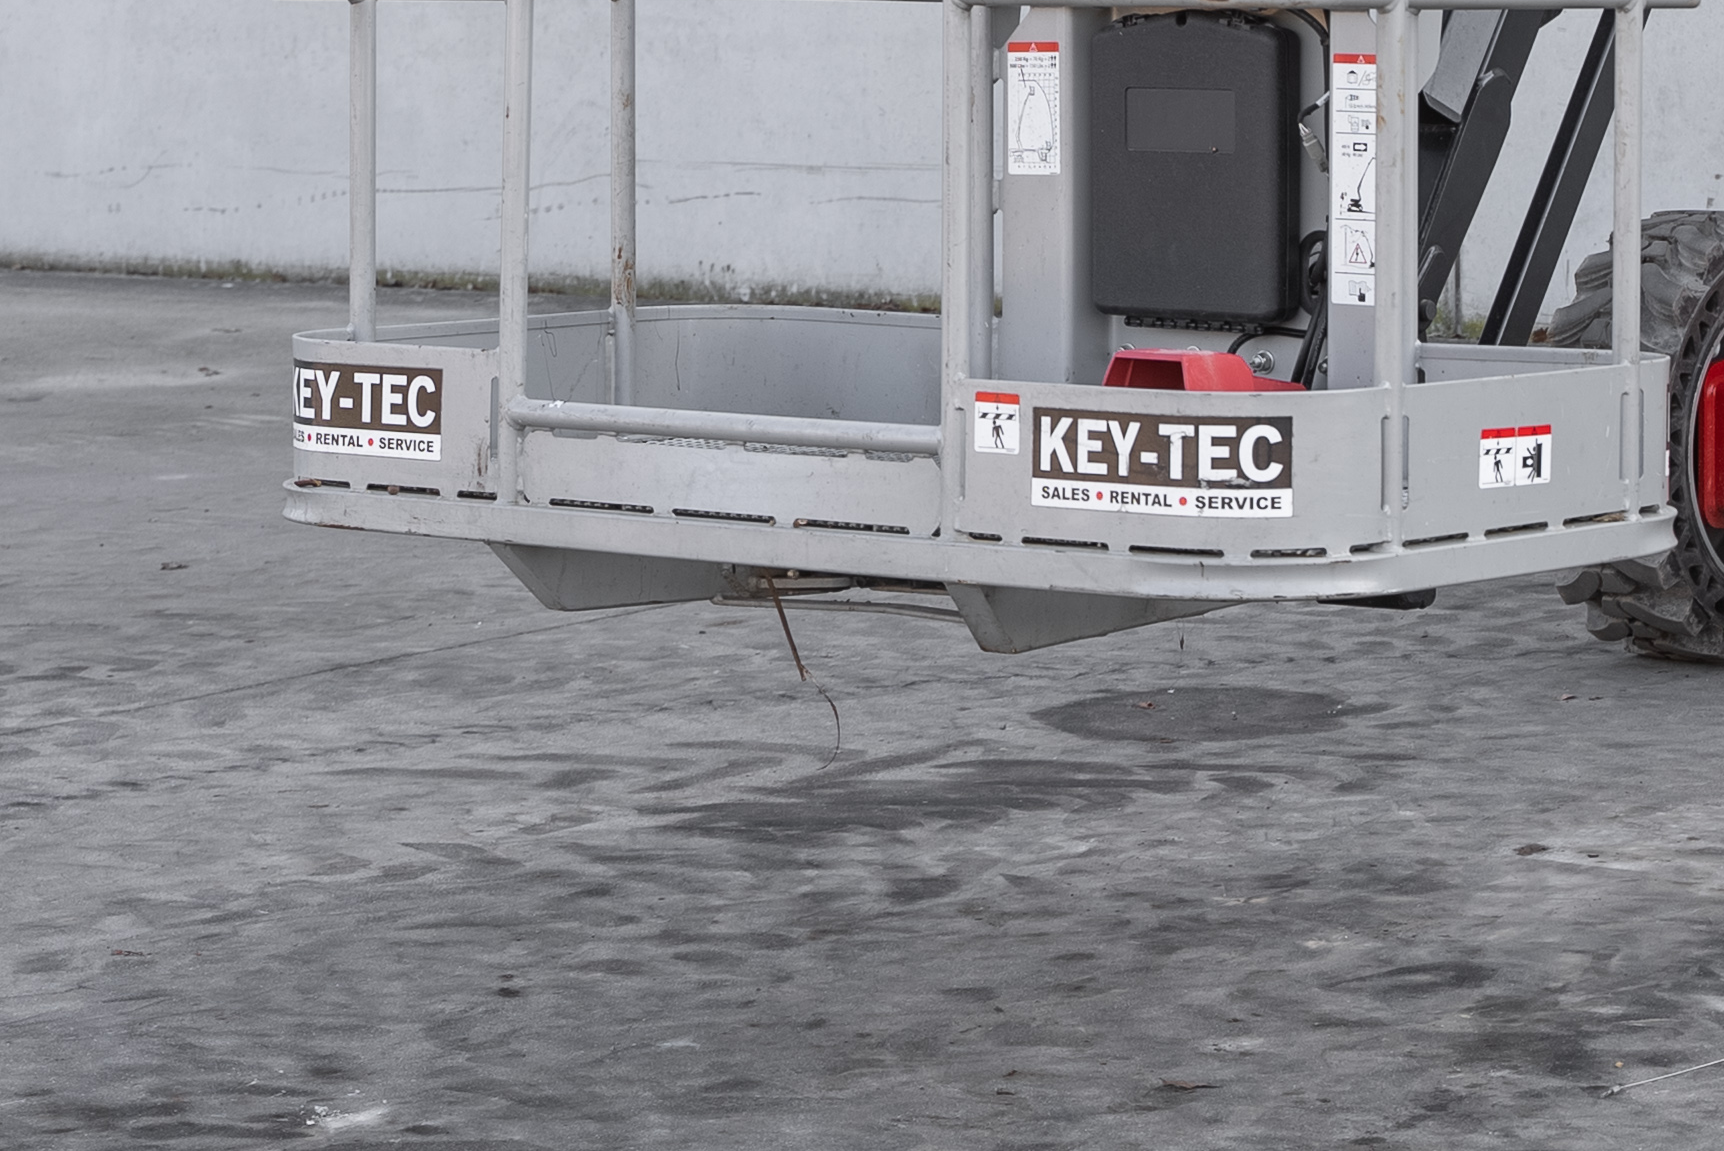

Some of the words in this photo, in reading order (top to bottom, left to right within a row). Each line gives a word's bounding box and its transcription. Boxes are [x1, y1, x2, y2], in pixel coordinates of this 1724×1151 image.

[315, 432, 363, 448] RENTAL
[378, 437, 434, 453] SERVICE
[1039, 415, 1284, 483] KEY-TEC
[1041, 485, 1090, 501] SALES
[1109, 490, 1172, 507] RENTAL
[1195, 495, 1282, 510] SERVICE
